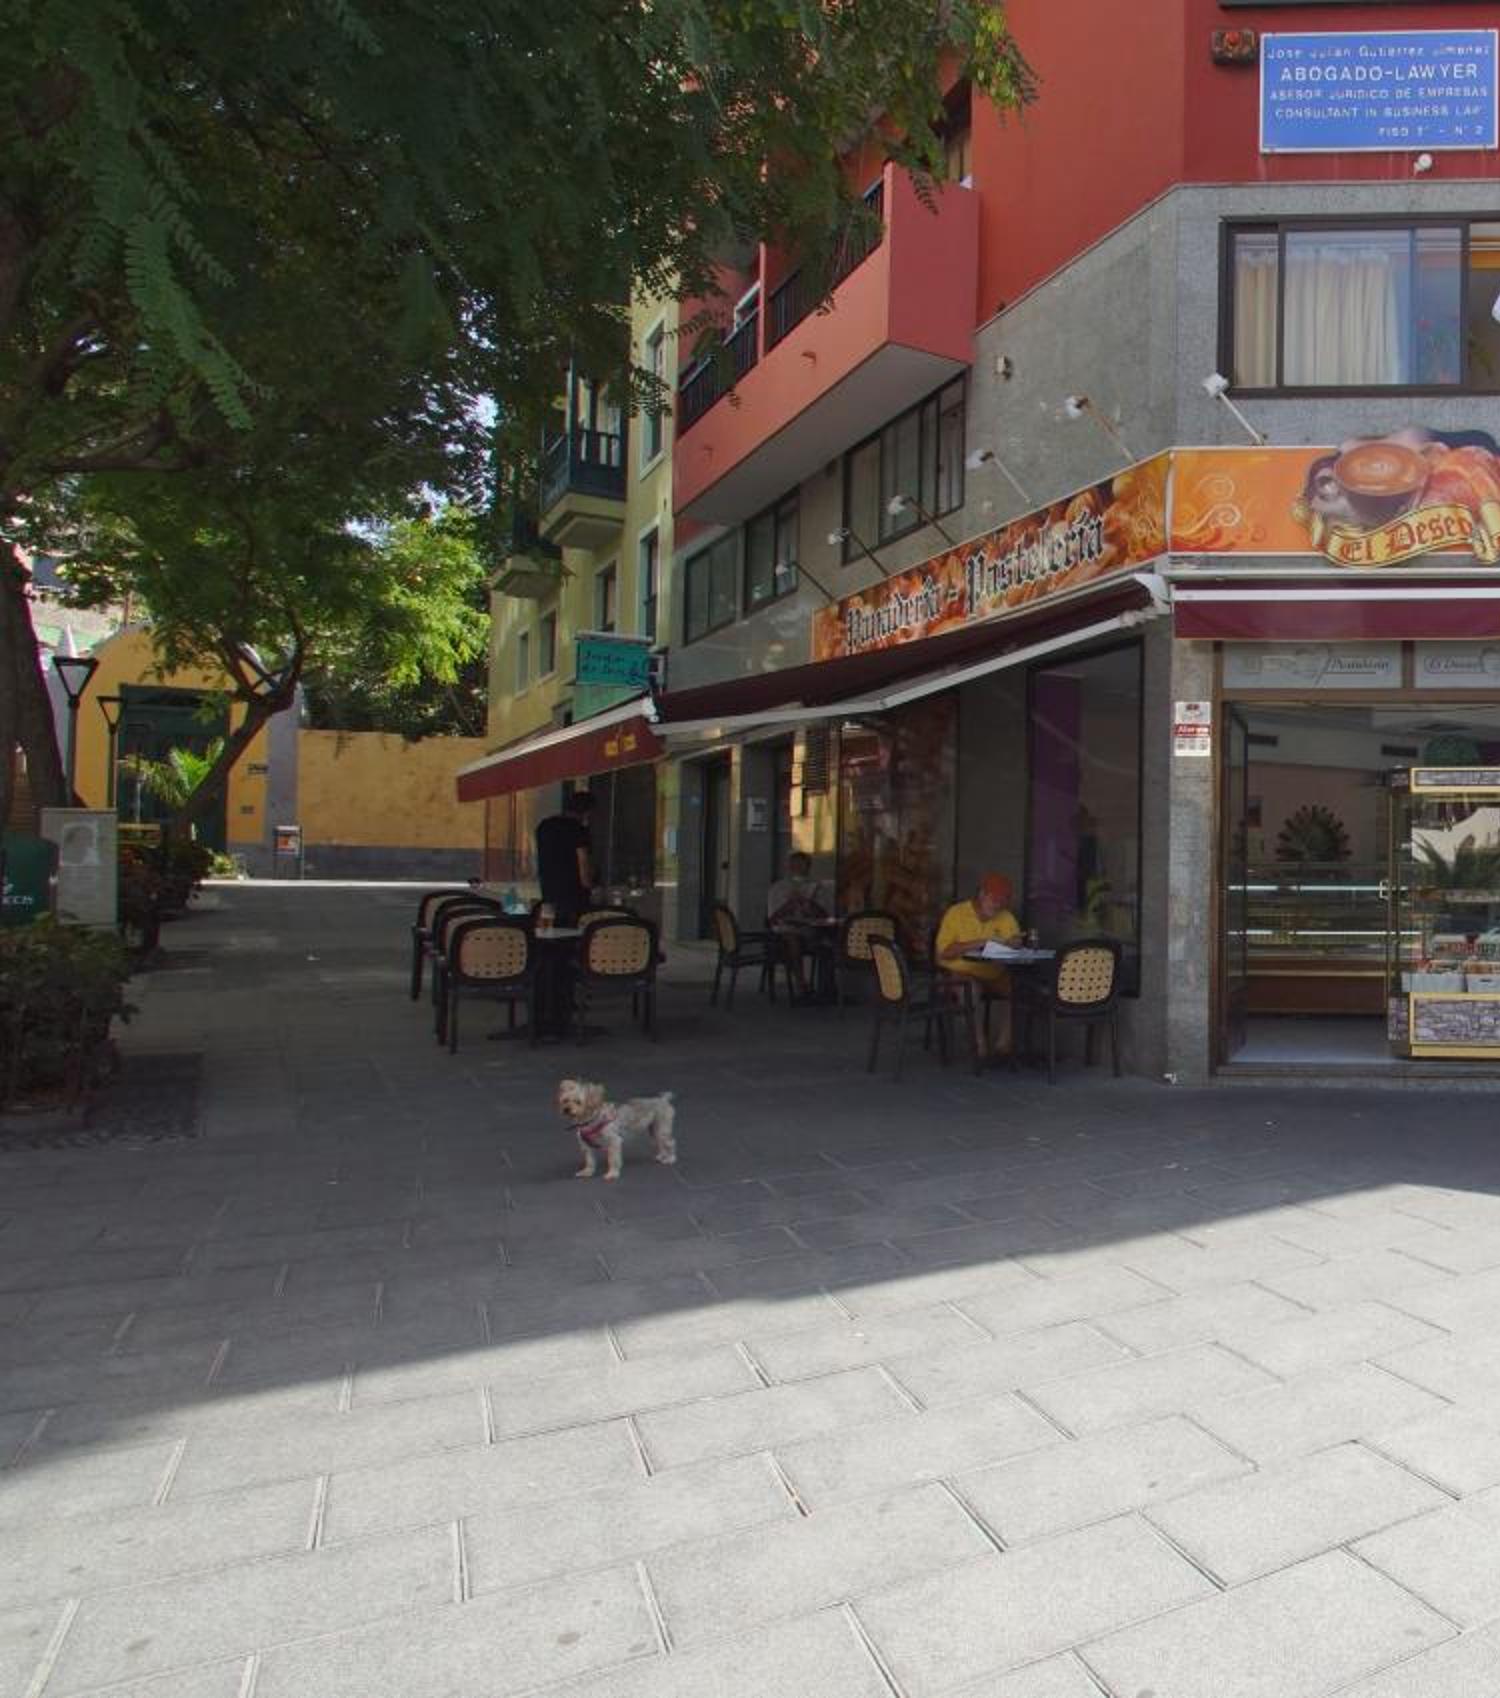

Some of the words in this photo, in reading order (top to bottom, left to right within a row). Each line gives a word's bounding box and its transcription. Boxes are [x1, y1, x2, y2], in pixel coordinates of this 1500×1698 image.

[1280, 63, 1478, 82] ABOGADO-LAWYER
[1395, 87, 1412, 99] DE
[1418, 86, 1488, 98] EMPRESAS
[1275, 106, 1359, 119] CONSULTANT
[1365, 107, 1378, 118] IN
[1383, 104, 1449, 118] BUSINESS
[1379, 126, 1410, 138] PISO
[1340, 538, 1377, 563] El
[1386, 513, 1473, 554] Deseo
